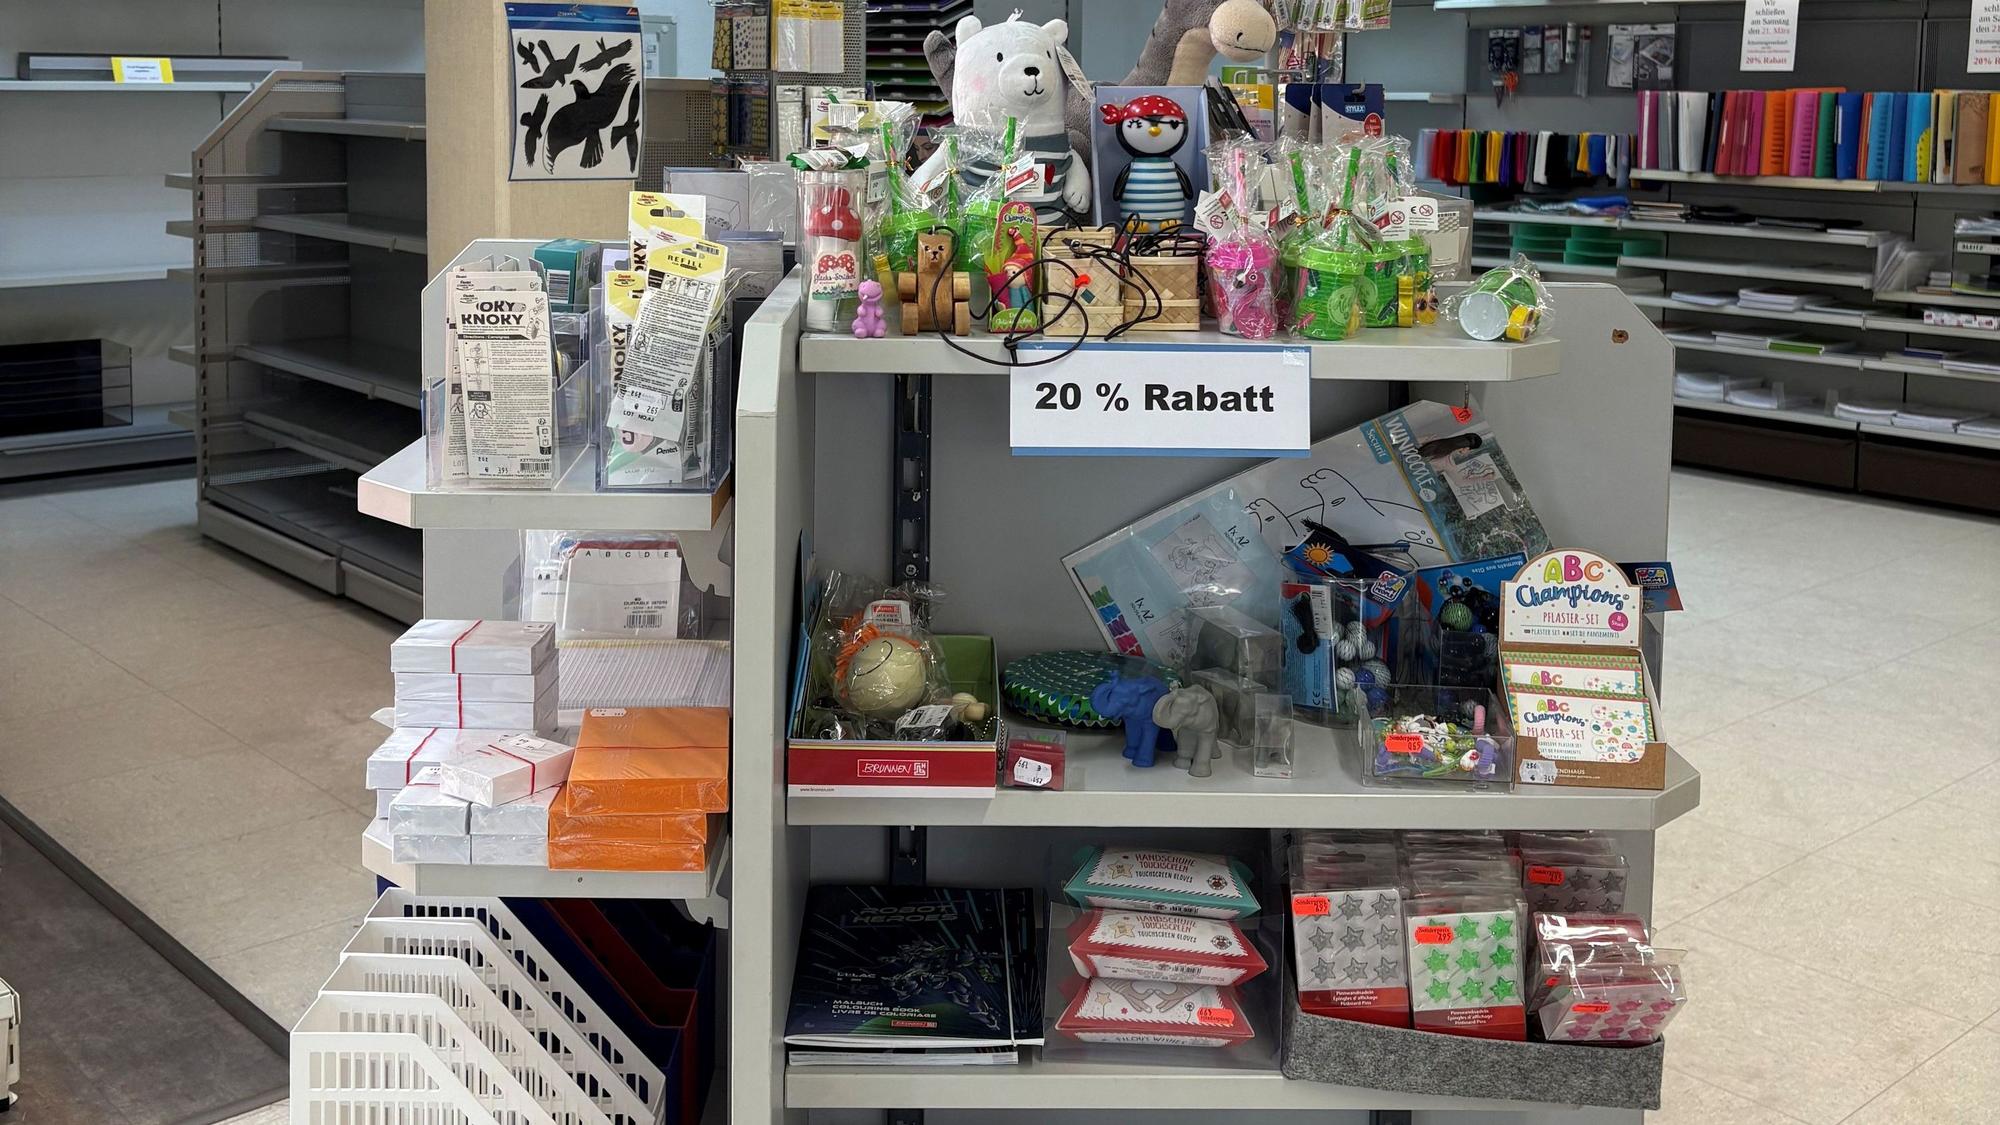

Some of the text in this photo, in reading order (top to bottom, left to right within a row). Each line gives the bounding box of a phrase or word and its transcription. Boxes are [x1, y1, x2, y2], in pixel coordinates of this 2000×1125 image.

[1755, 8, 1785, 16] schließen
[1763, 18, 1790, 26] Samstag
[1976, 25, 1989, 33] den
[667, 255, 702, 269] REFILL
[461, 314, 523, 325] KNOKY
[1035, 382, 1275, 412] 20 % Rabatt
[1367, 428, 1387, 458] Securit
[1543, 555, 1604, 584] ABC
[1516, 584, 1624, 611] Champions
[1543, 611, 1599, 626] PFLASTER-SET
[1531, 628, 1550, 636] PLASTER
[1531, 671, 1563, 685] ABC
[1537, 699, 1570, 712] ABC
[1524, 711, 1586, 726] Champions
[1526, 727, 1585, 740] PFLASTER-SET
[862, 763, 912, 774] BRUNNEN
[1135, 853, 1198, 866] HANDSCHUHE
[1139, 861, 1189, 873] TOUCHSCREEN
[1136, 871, 1193, 883] TOUCHSCREEN GLOVES
[853, 913, 958, 923] HEROES
[1136, 915, 1197, 927] HANDSCHUHE
[1141, 922, 1191, 934] TOUCHSCREEN
[1137, 930, 1197, 944] TOUCHSCREEN GLOVES
